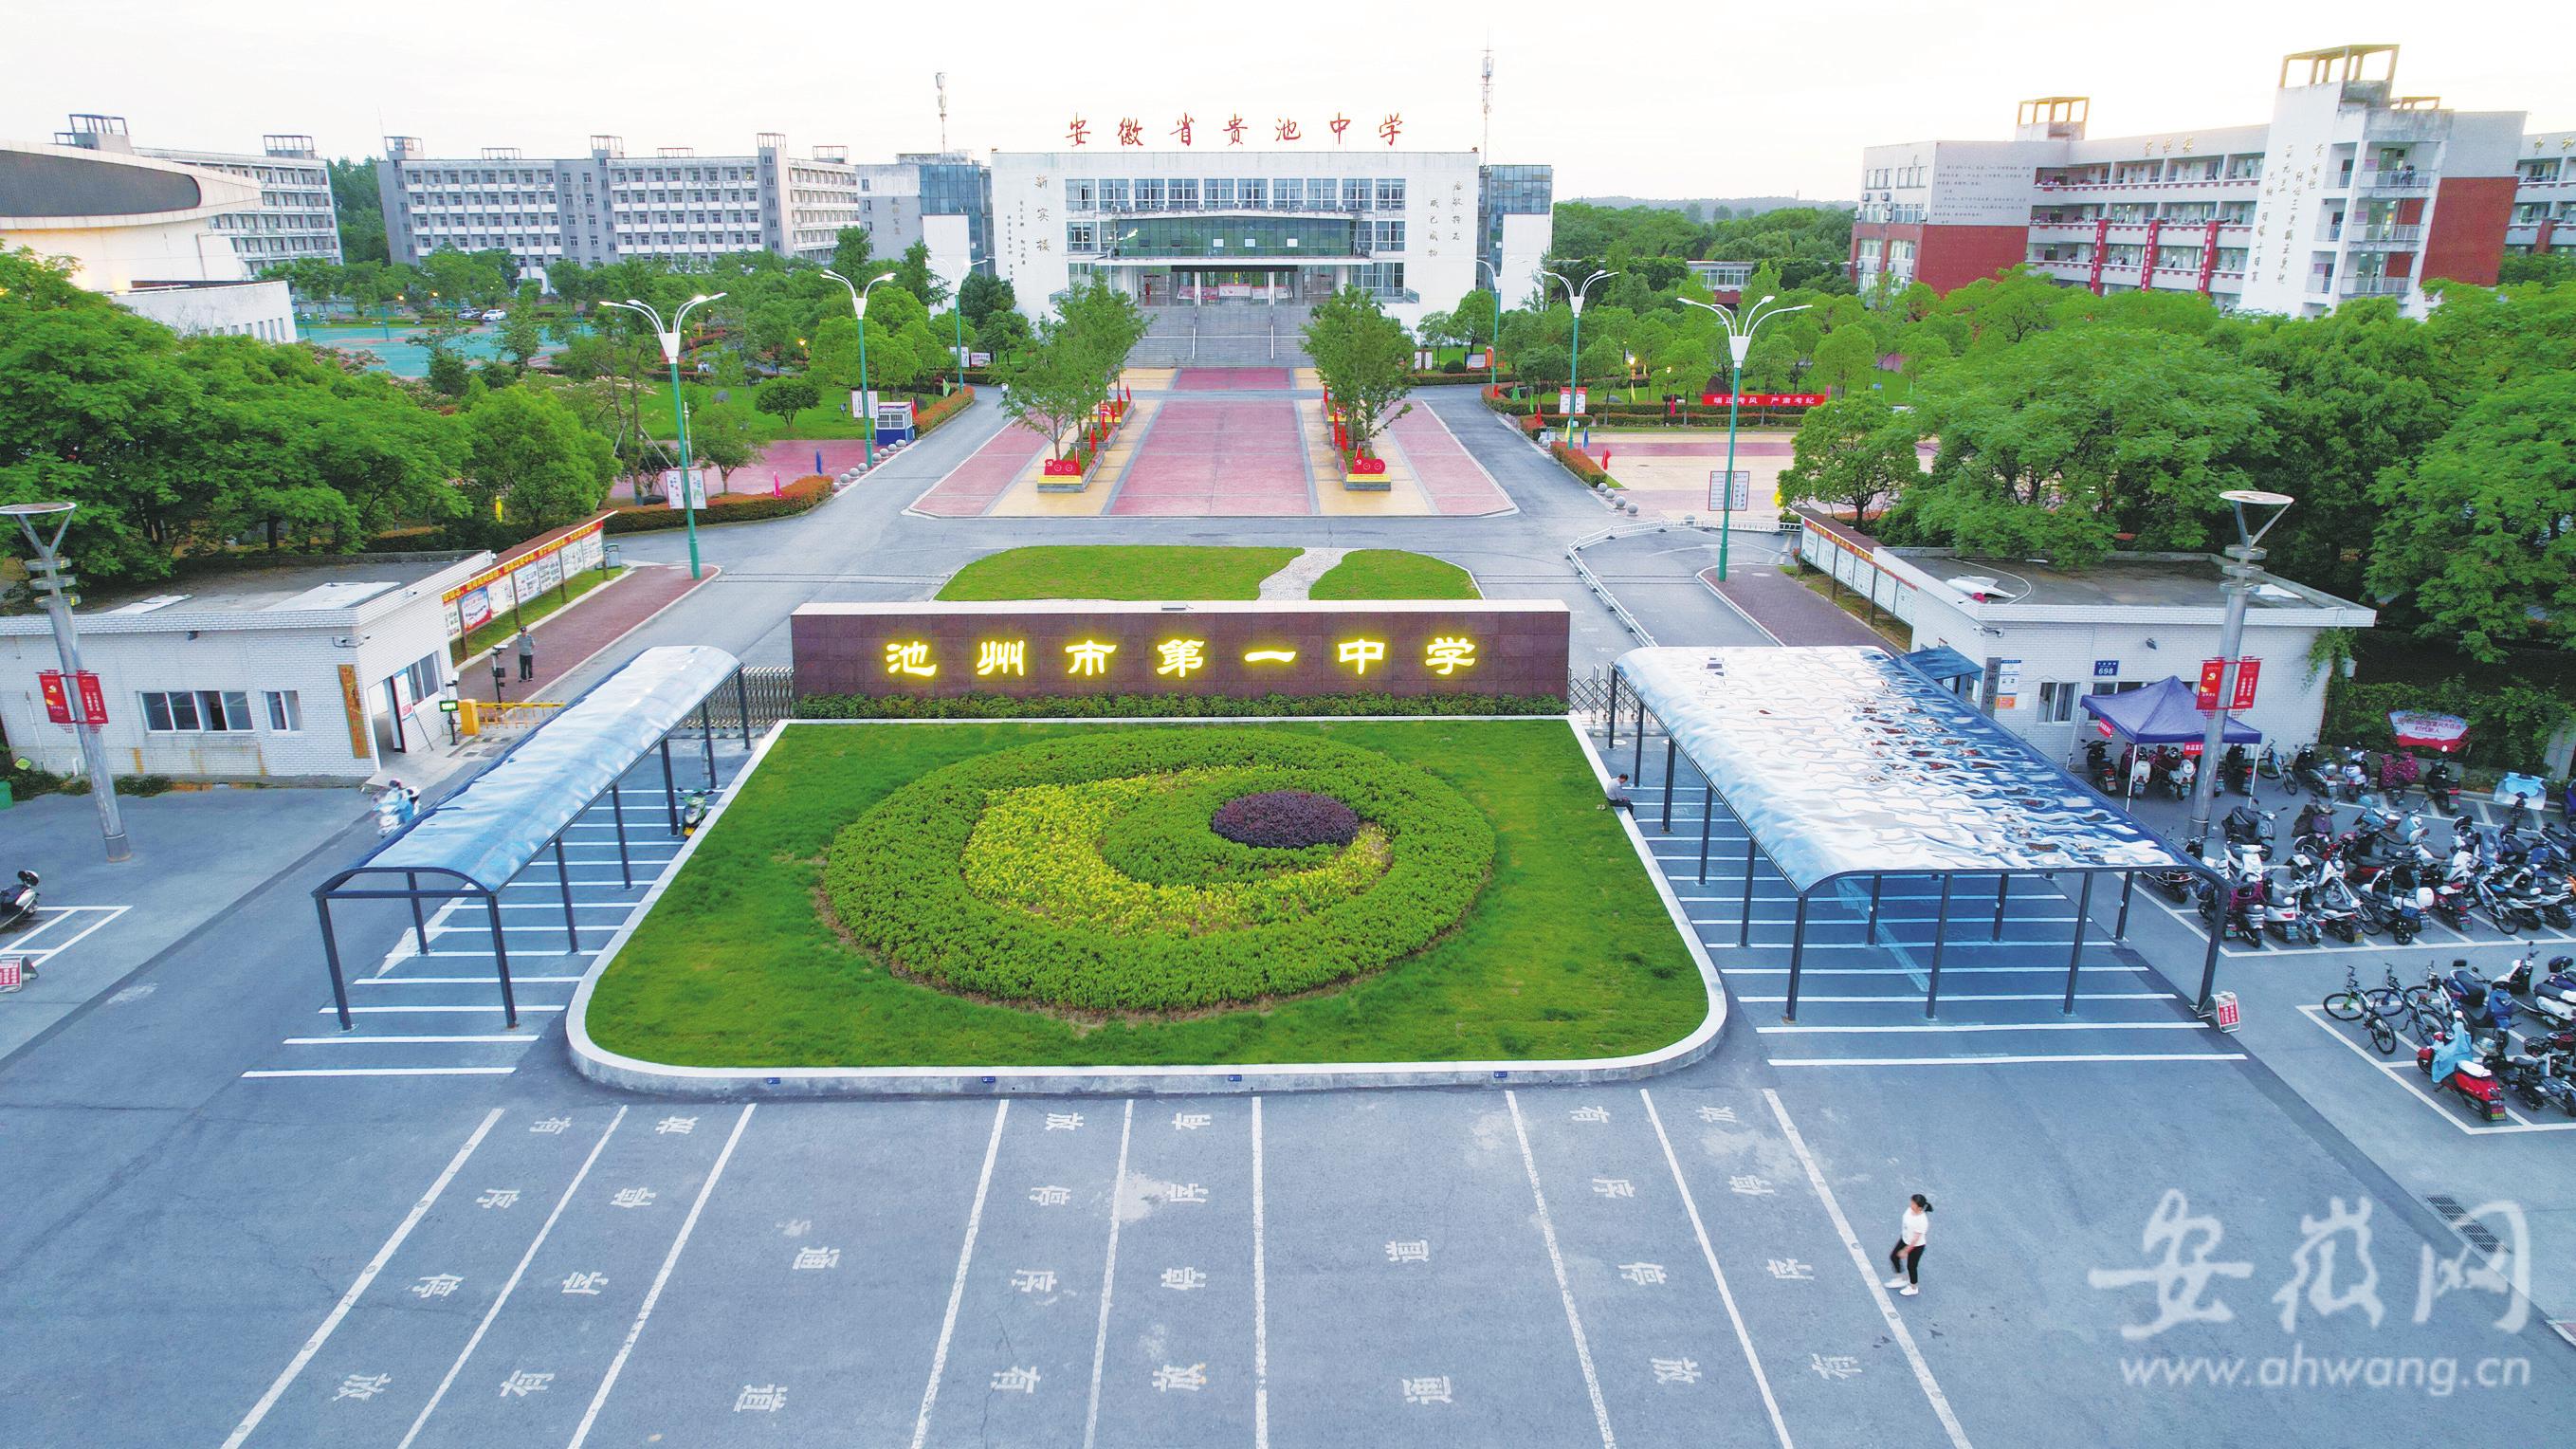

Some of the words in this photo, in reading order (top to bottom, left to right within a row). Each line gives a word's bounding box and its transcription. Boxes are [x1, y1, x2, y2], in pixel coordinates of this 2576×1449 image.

[1065, 112, 1403, 147] 安徽省贵池中学
[1713, 396, 1758, 405] 端正考风
[1770, 396, 1815, 405] 严肃考纪
[886, 635, 1475, 676] 池州市第一中学
